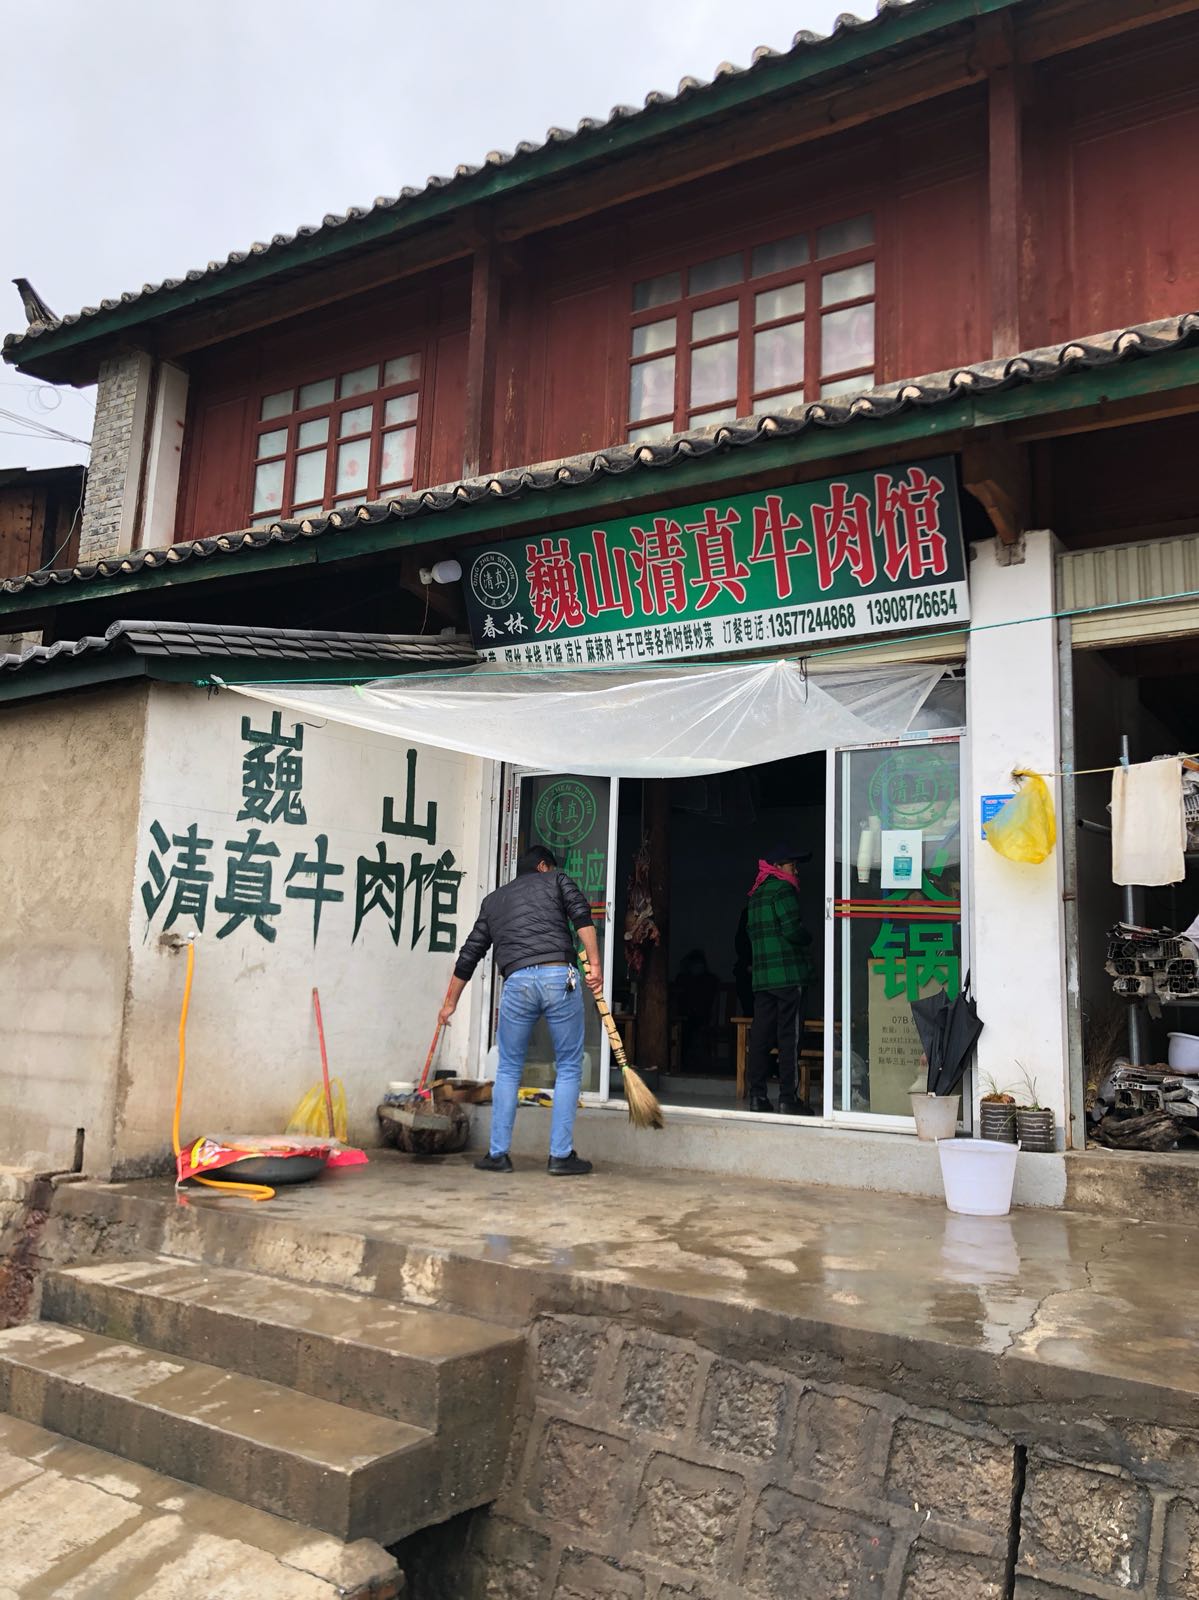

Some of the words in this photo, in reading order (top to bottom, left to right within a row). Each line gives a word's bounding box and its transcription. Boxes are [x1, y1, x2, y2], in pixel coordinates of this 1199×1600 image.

[479, 555, 495, 567] ZHEN
[497, 556, 508, 567] SHI
[526, 467, 948, 633] 巍山清真牛肉馆
[483, 568, 506, 590] 清真
[481, 612, 529, 639] 春林
[586, 635, 614, 662] 麻辣肉
[617, 621, 714, 659] 牛干巴等各种时鲜炒菜
[867, 588, 957, 625] 13908726654
[141, 819, 463, 952] 清真牛肉馆
